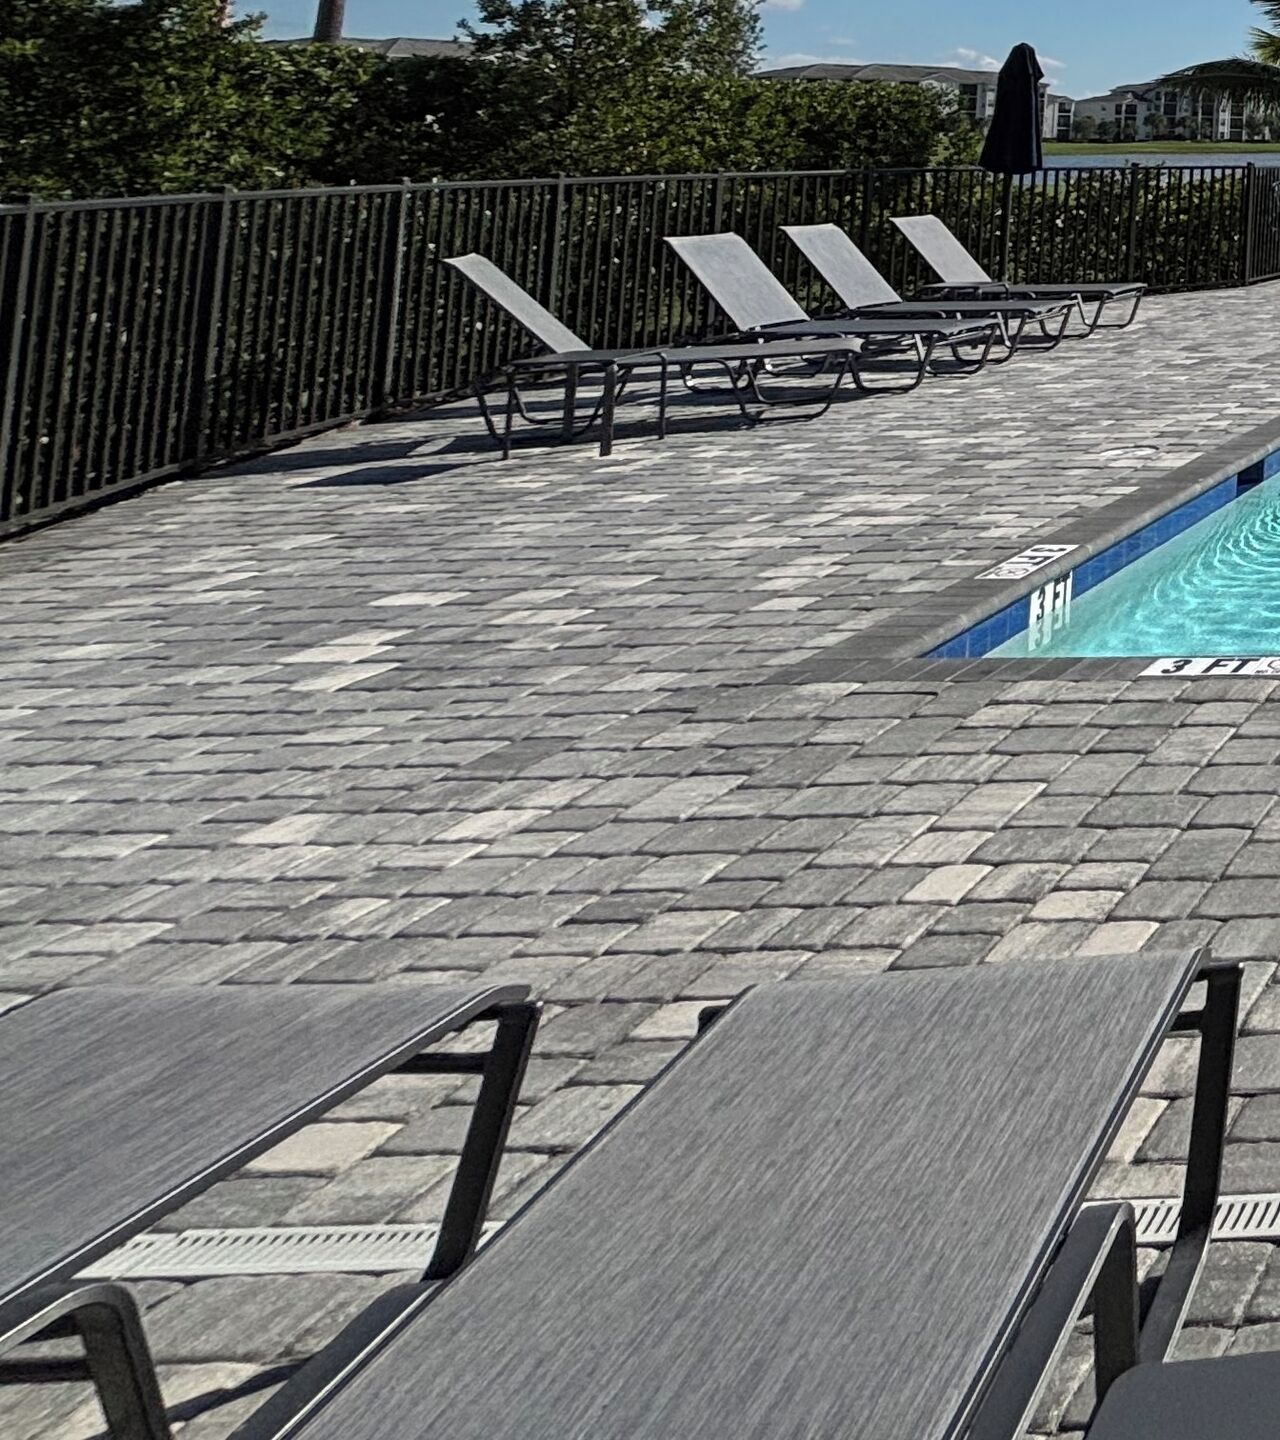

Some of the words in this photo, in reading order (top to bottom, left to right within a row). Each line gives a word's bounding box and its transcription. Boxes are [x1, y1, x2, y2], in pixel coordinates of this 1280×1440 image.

[1005, 555, 1056, 566] FT
[1036, 585, 1046, 622] 3
[1051, 571, 1071, 612] FT
[1161, 659, 1193, 674] 3
[1201, 658, 1262, 674] FT
